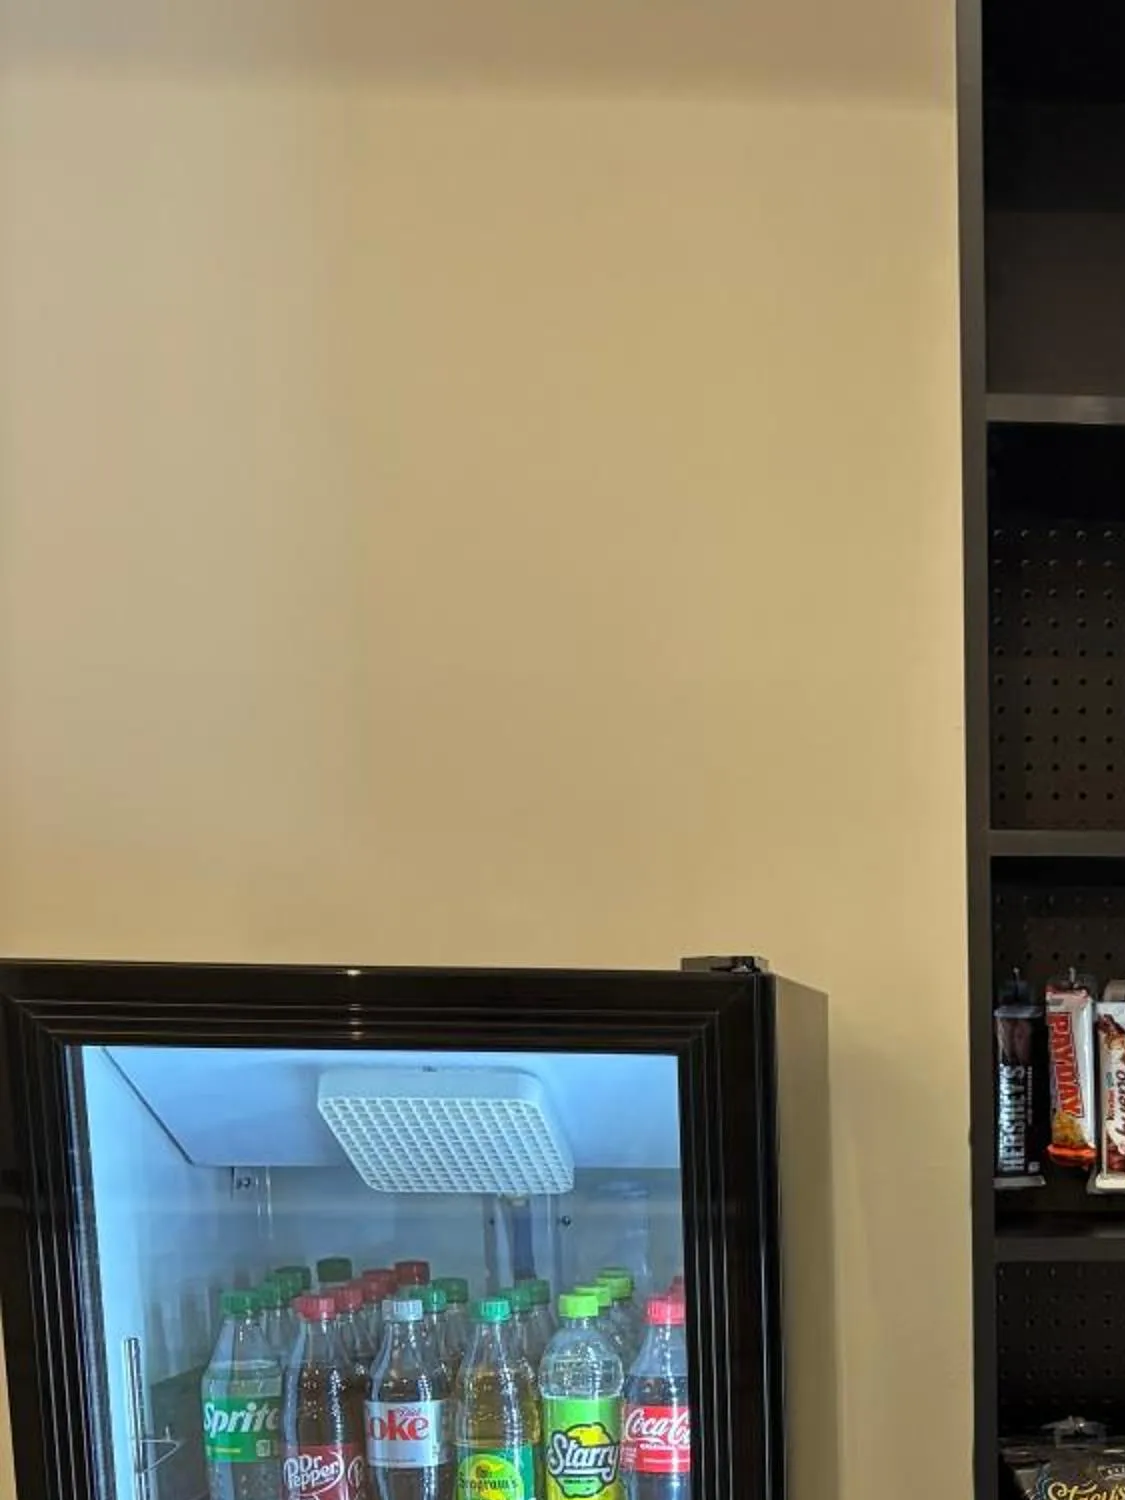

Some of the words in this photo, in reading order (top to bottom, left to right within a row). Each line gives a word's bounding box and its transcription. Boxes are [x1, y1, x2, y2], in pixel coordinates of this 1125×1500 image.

[1049, 1011, 1084, 1118] PAYDAY
[367, 1410, 430, 1441] oke
[284, 1456, 341, 1490] Pepper
[298, 1453, 323, 1473] Dr
[548, 1431, 620, 1482] Starry
